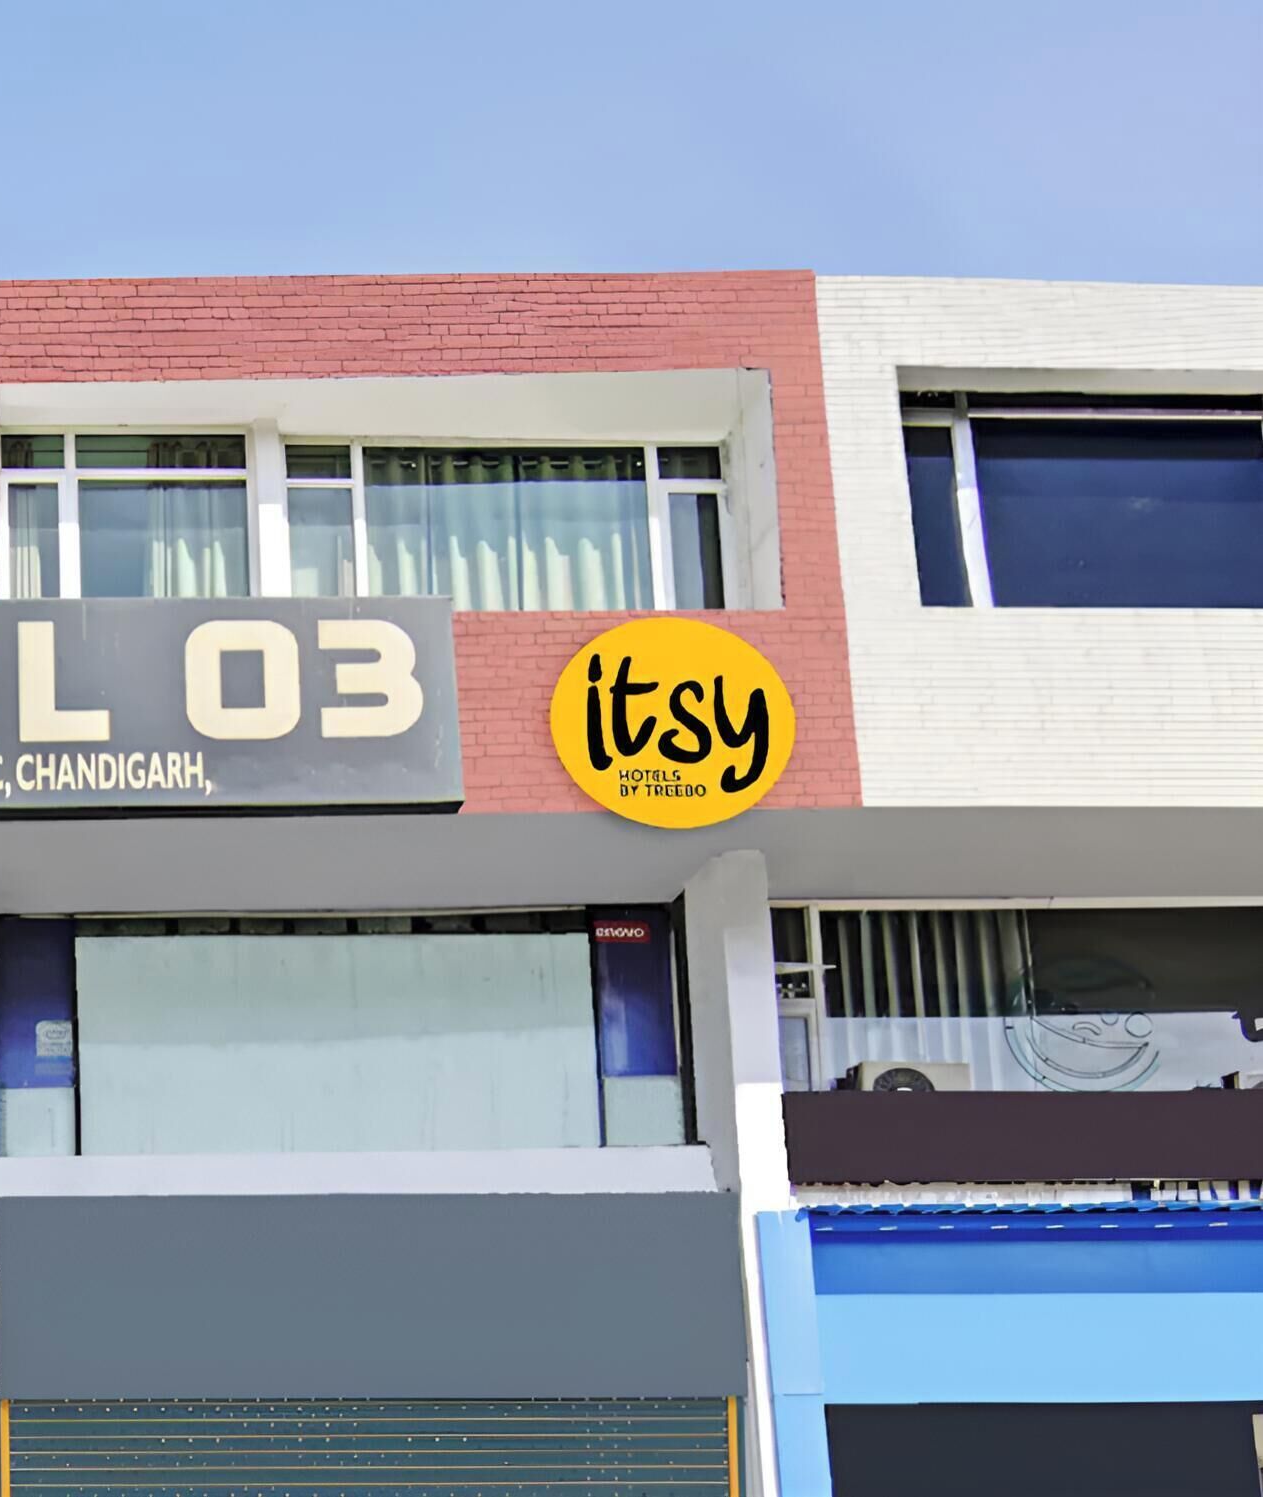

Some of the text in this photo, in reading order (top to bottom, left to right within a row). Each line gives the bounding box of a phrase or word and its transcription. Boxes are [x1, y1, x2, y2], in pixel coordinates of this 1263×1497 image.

[587, 653, 770, 793] itsy
[16, 751, 213, 796] CHANDIGARH,
[619, 769, 682, 782] HOTELS
[620, 784, 707, 797] BY TREEBO
